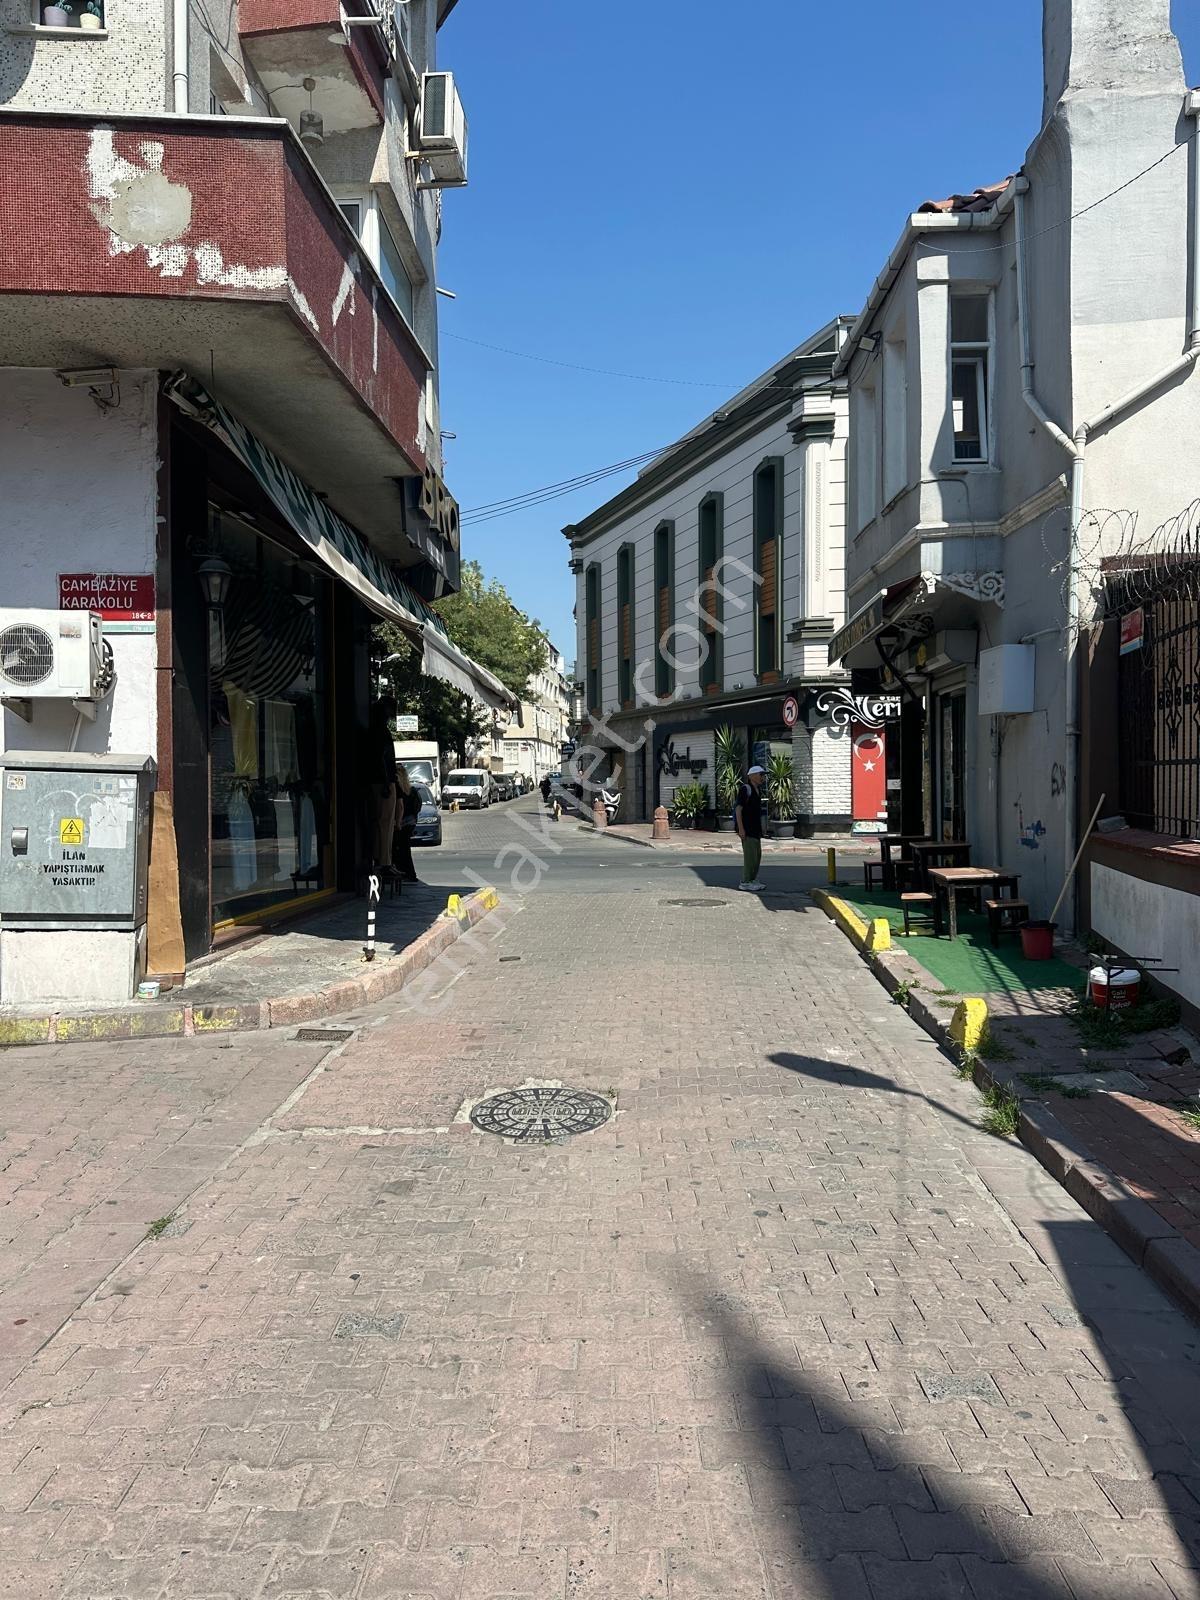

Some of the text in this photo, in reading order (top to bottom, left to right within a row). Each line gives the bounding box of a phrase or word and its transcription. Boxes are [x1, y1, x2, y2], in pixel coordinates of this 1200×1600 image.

[61, 577, 138, 592] CAMBAZİYE
[62, 596, 133, 609] KARAKOLU
[62, 849, 86, 860] İLAN
[43, 864, 105, 875] YAPIŞTIRMAK
